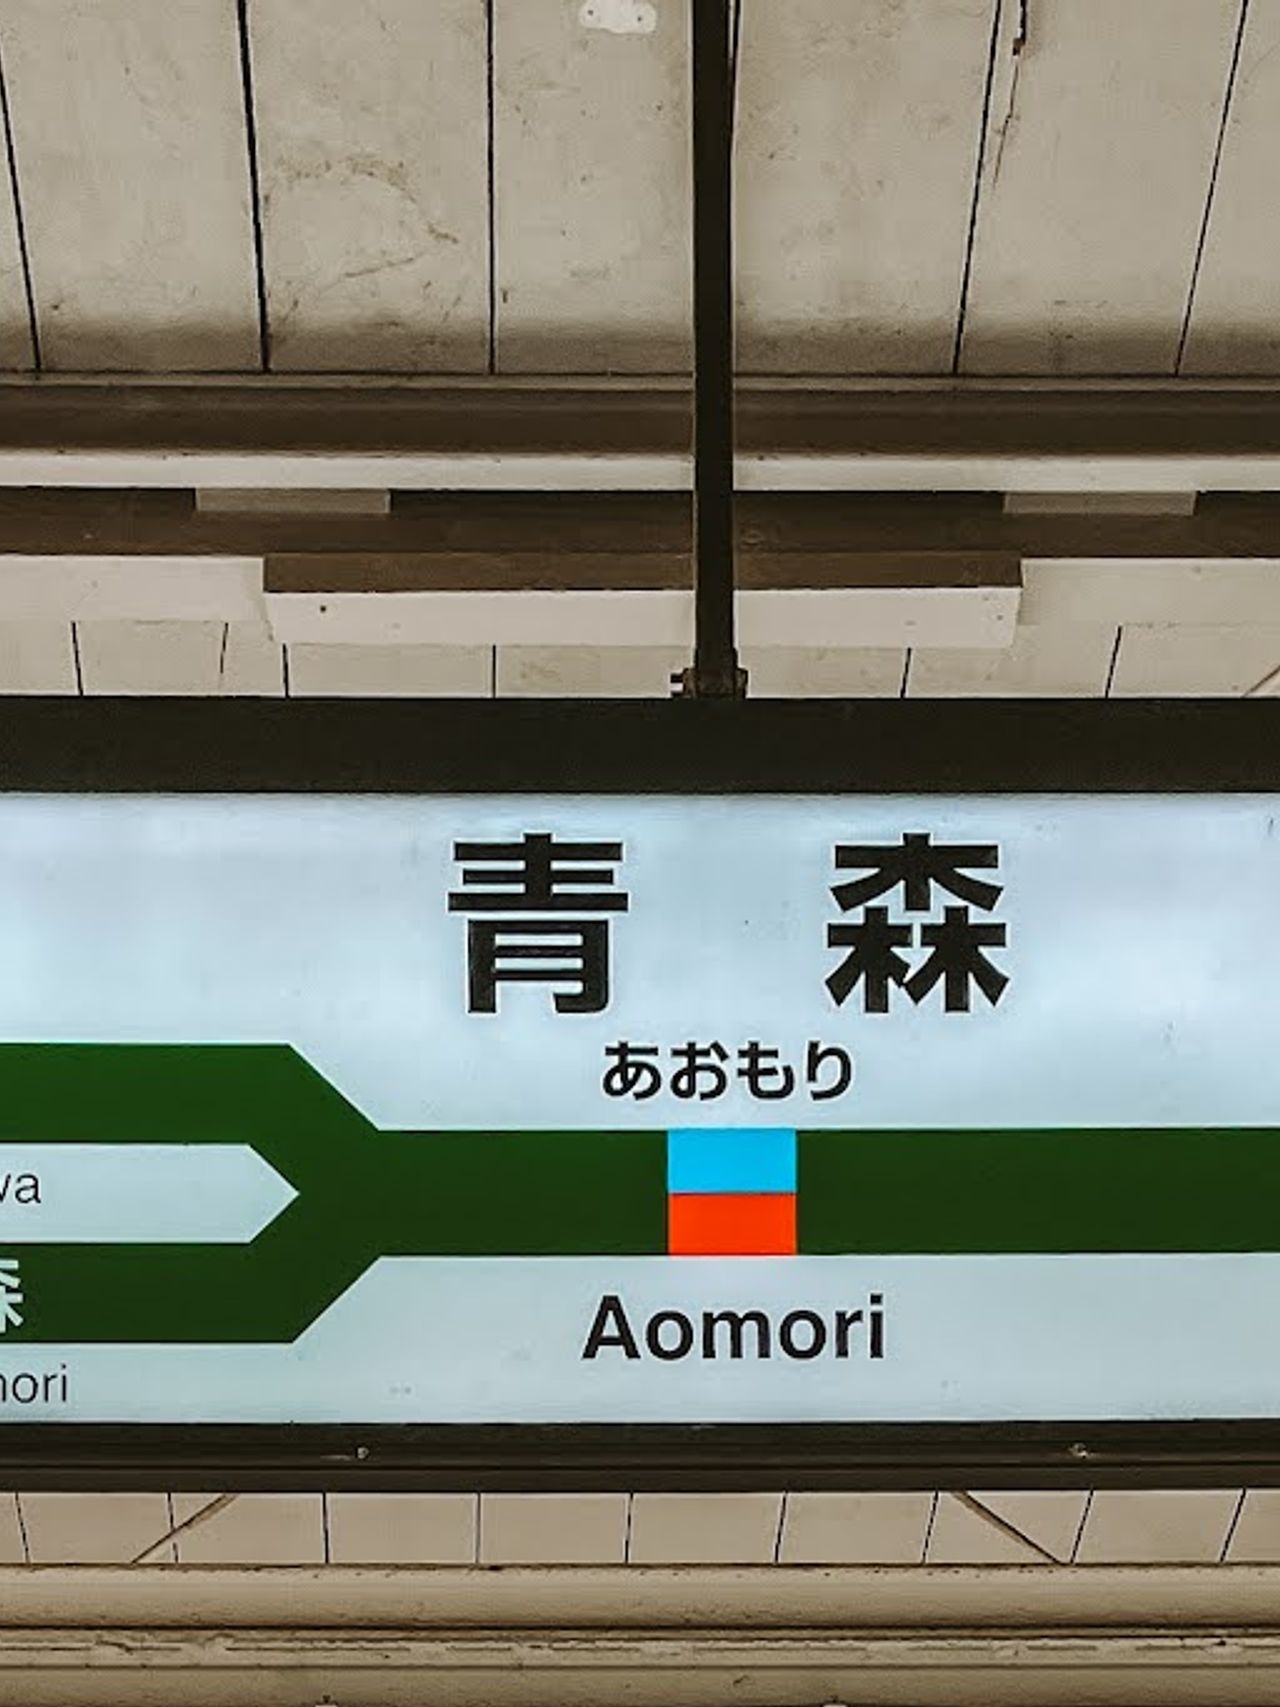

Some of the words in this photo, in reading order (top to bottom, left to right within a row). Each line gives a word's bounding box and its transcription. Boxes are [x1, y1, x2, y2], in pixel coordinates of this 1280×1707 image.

[601, 1041, 853, 1101] あおもり
[582, 1294, 885, 1360] Aomori
